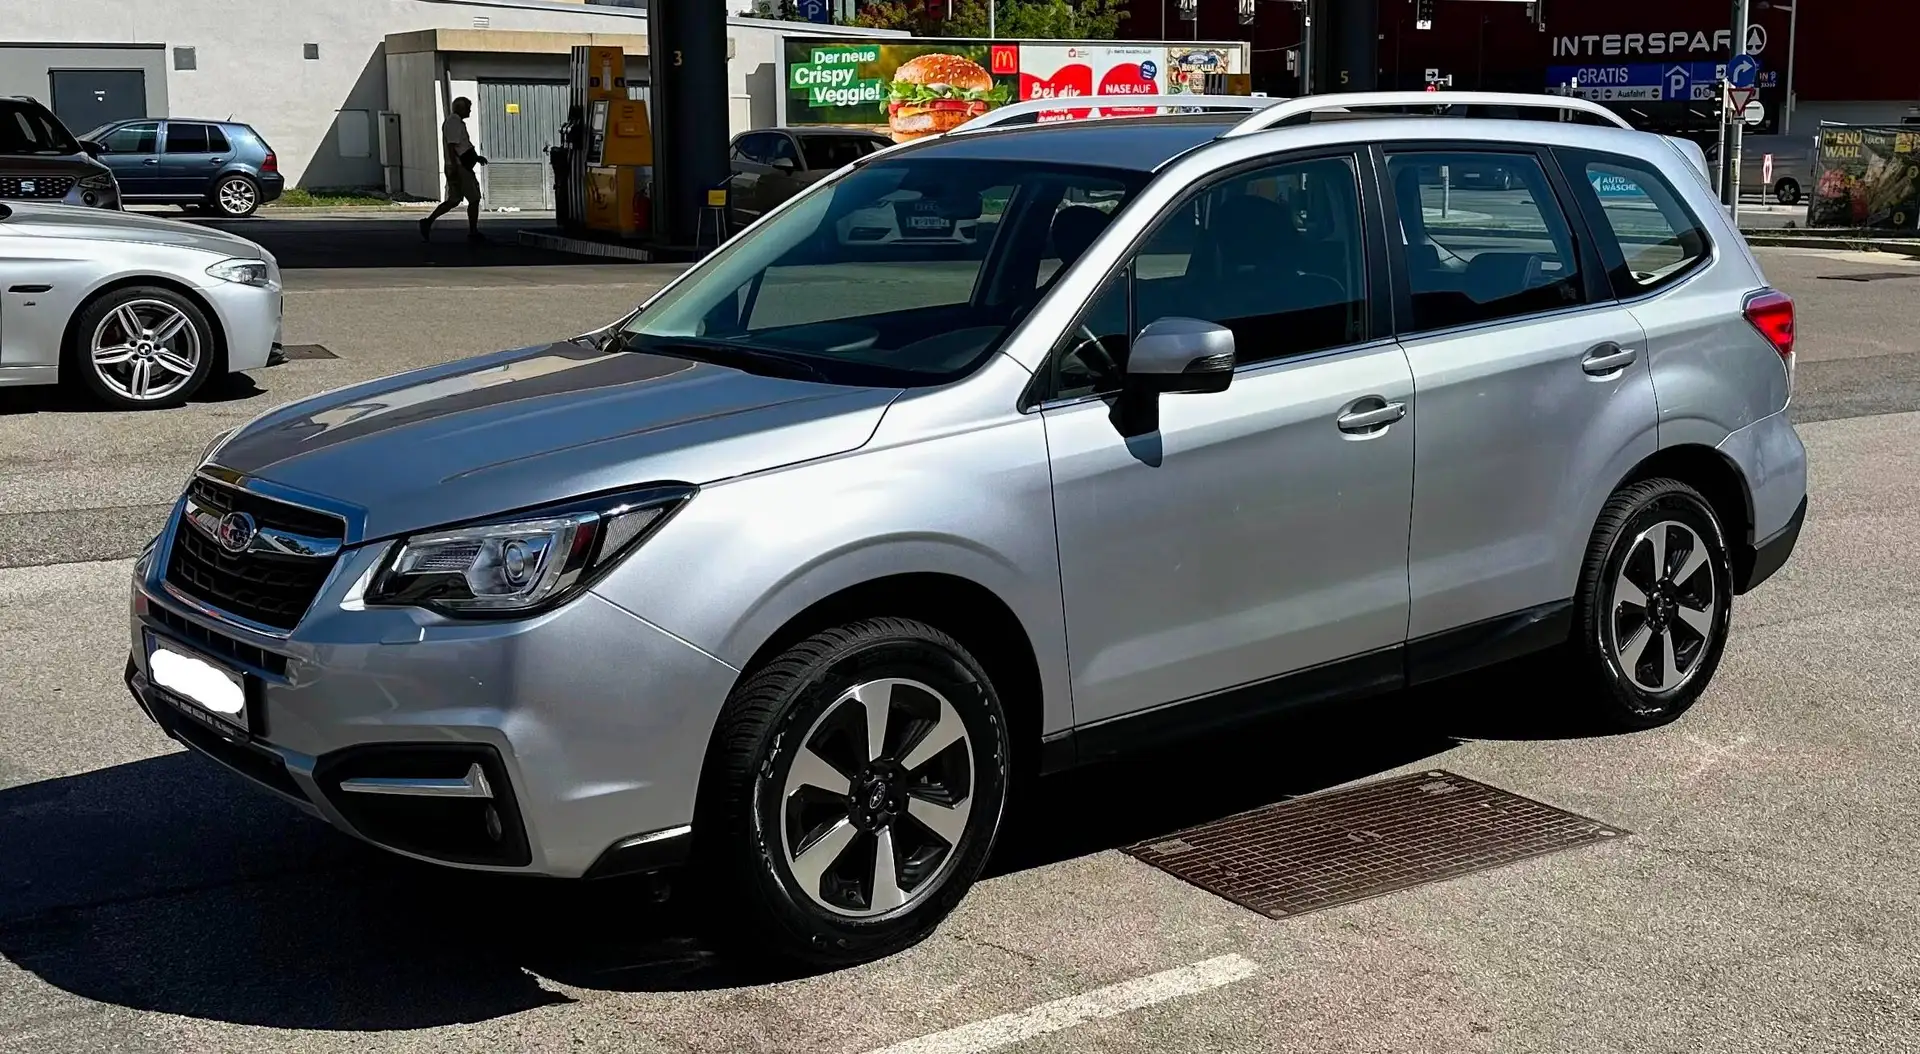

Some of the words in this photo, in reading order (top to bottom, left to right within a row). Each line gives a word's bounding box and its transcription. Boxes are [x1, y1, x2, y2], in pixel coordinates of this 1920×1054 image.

[673, 50, 683, 66] 3
[814, 51, 840, 64] Der
[841, 51, 876, 63] neue
[795, 65, 855, 87] Crispy
[1340, 70, 1349, 83] 5
[1577, 67, 1629, 84] GRATIS
[813, 83, 881, 106] Veggie!
[1030, 81, 1056, 99] Bei
[1105, 83, 1132, 94] NASE
[1132, 83, 1152, 94] AUF
[1617, 89, 1646, 99] Ausfahrt
[1824, 145, 1862, 158] WAHL
[1602, 176, 1626, 184] AUTO
